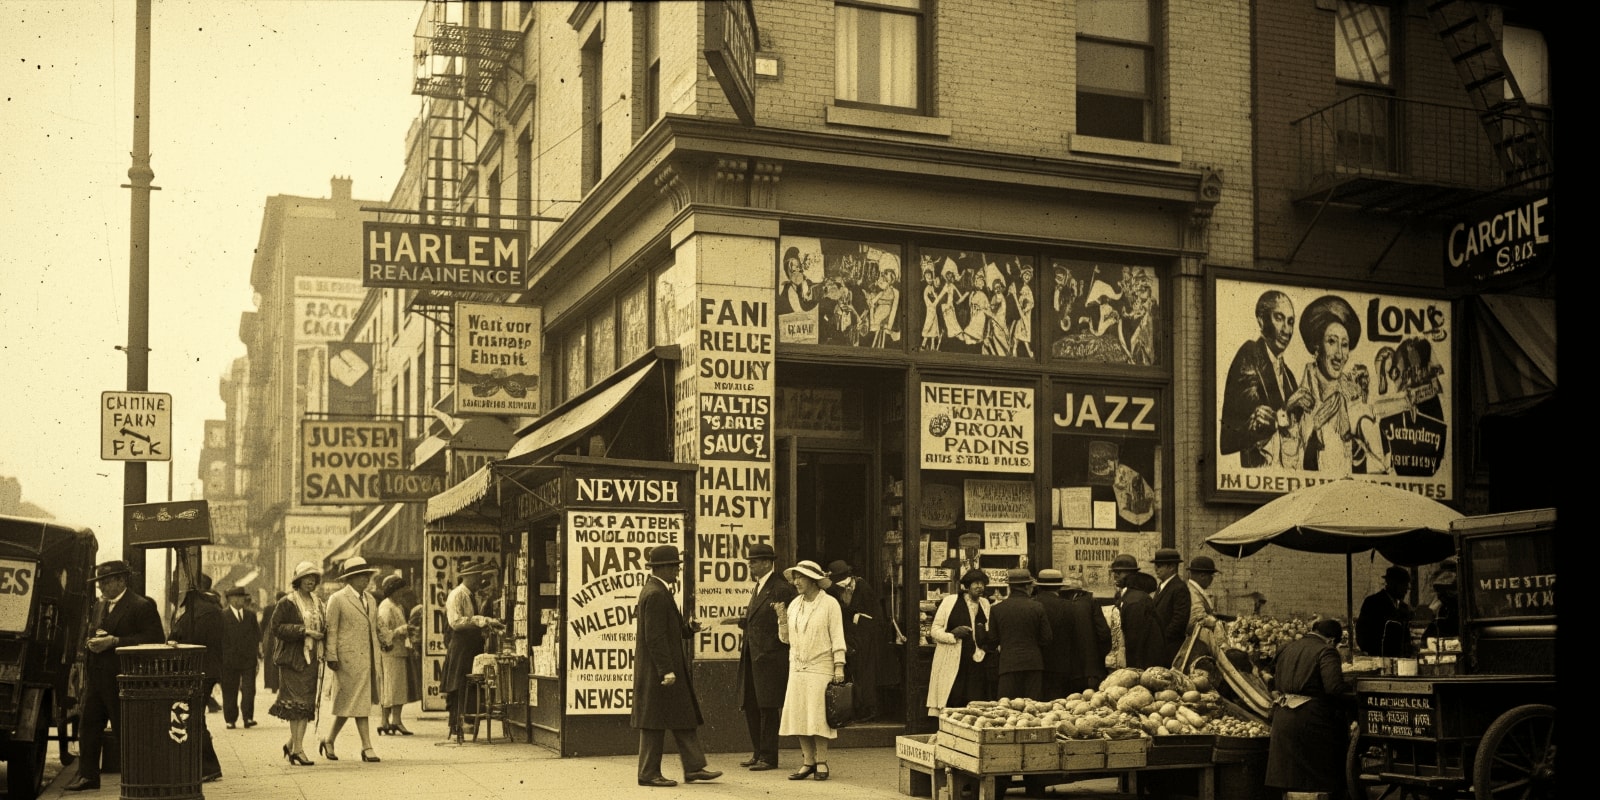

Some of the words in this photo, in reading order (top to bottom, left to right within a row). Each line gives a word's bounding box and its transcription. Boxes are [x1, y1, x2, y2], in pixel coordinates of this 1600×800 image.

[369, 230, 519, 268] HARLEM
[700, 298, 767, 328] FANI
[1053, 393, 1156, 432] JAZZ
[311, 452, 400, 468] HOVONS
[575, 478, 679, 503] NEWISH
[699, 466, 771, 492] HALIM
[699, 494, 771, 519] HASTY
